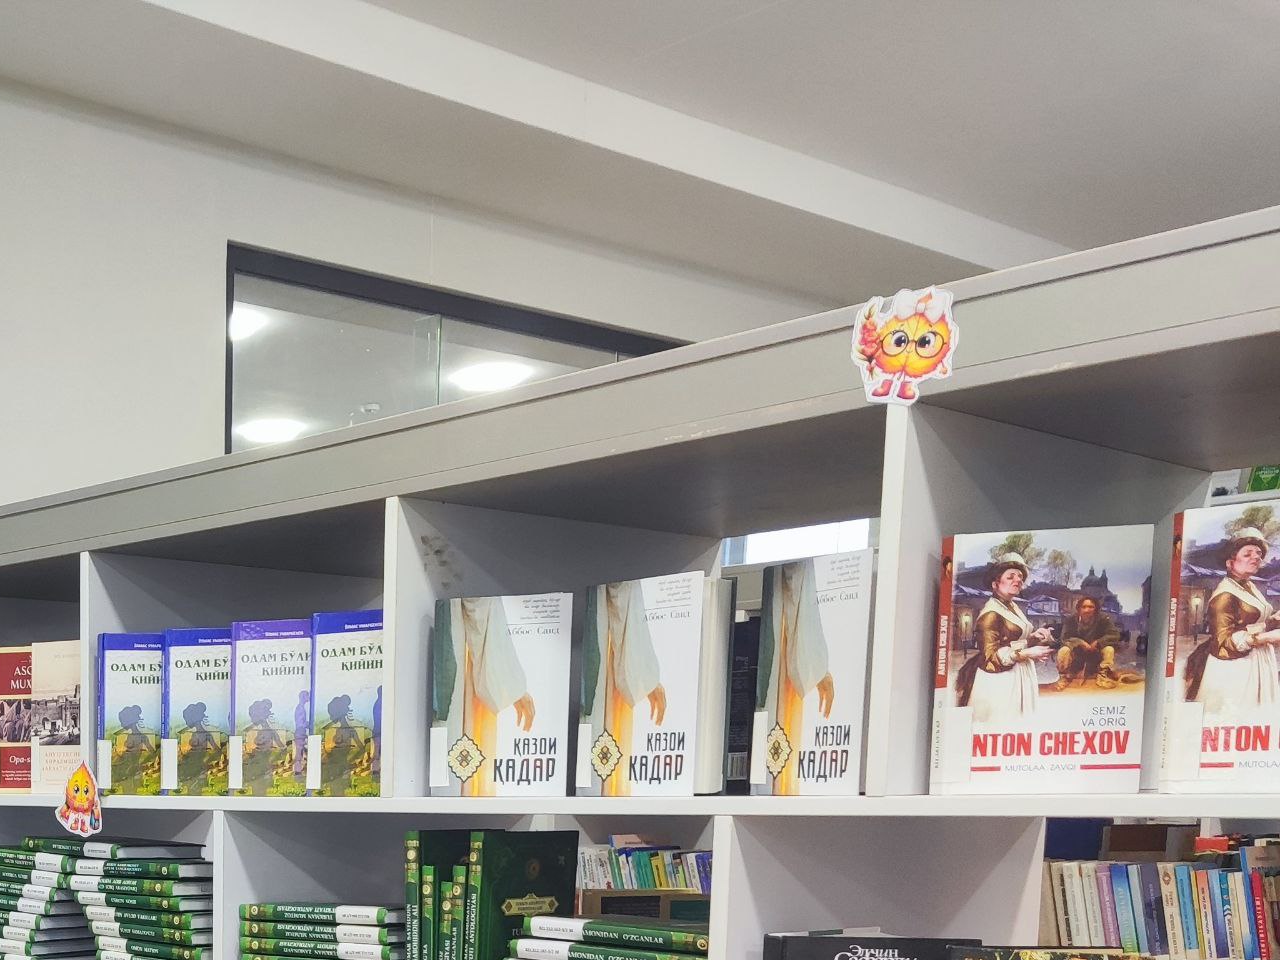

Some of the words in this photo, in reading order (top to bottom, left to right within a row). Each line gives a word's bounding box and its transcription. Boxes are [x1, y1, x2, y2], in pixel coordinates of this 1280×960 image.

[321, 646, 356, 658] ОДАМ
[241, 653, 277, 663] ОДАМ
[111, 663, 146, 672] ОДАМ
[175, 659, 210, 669] ОДАМ
[1091, 705, 1127, 716] SEMIZ
[1081, 718, 1096, 728] VA
[1098, 716, 1127, 728] ORIQ
[1039, 730, 1131, 756] CHEXOV
